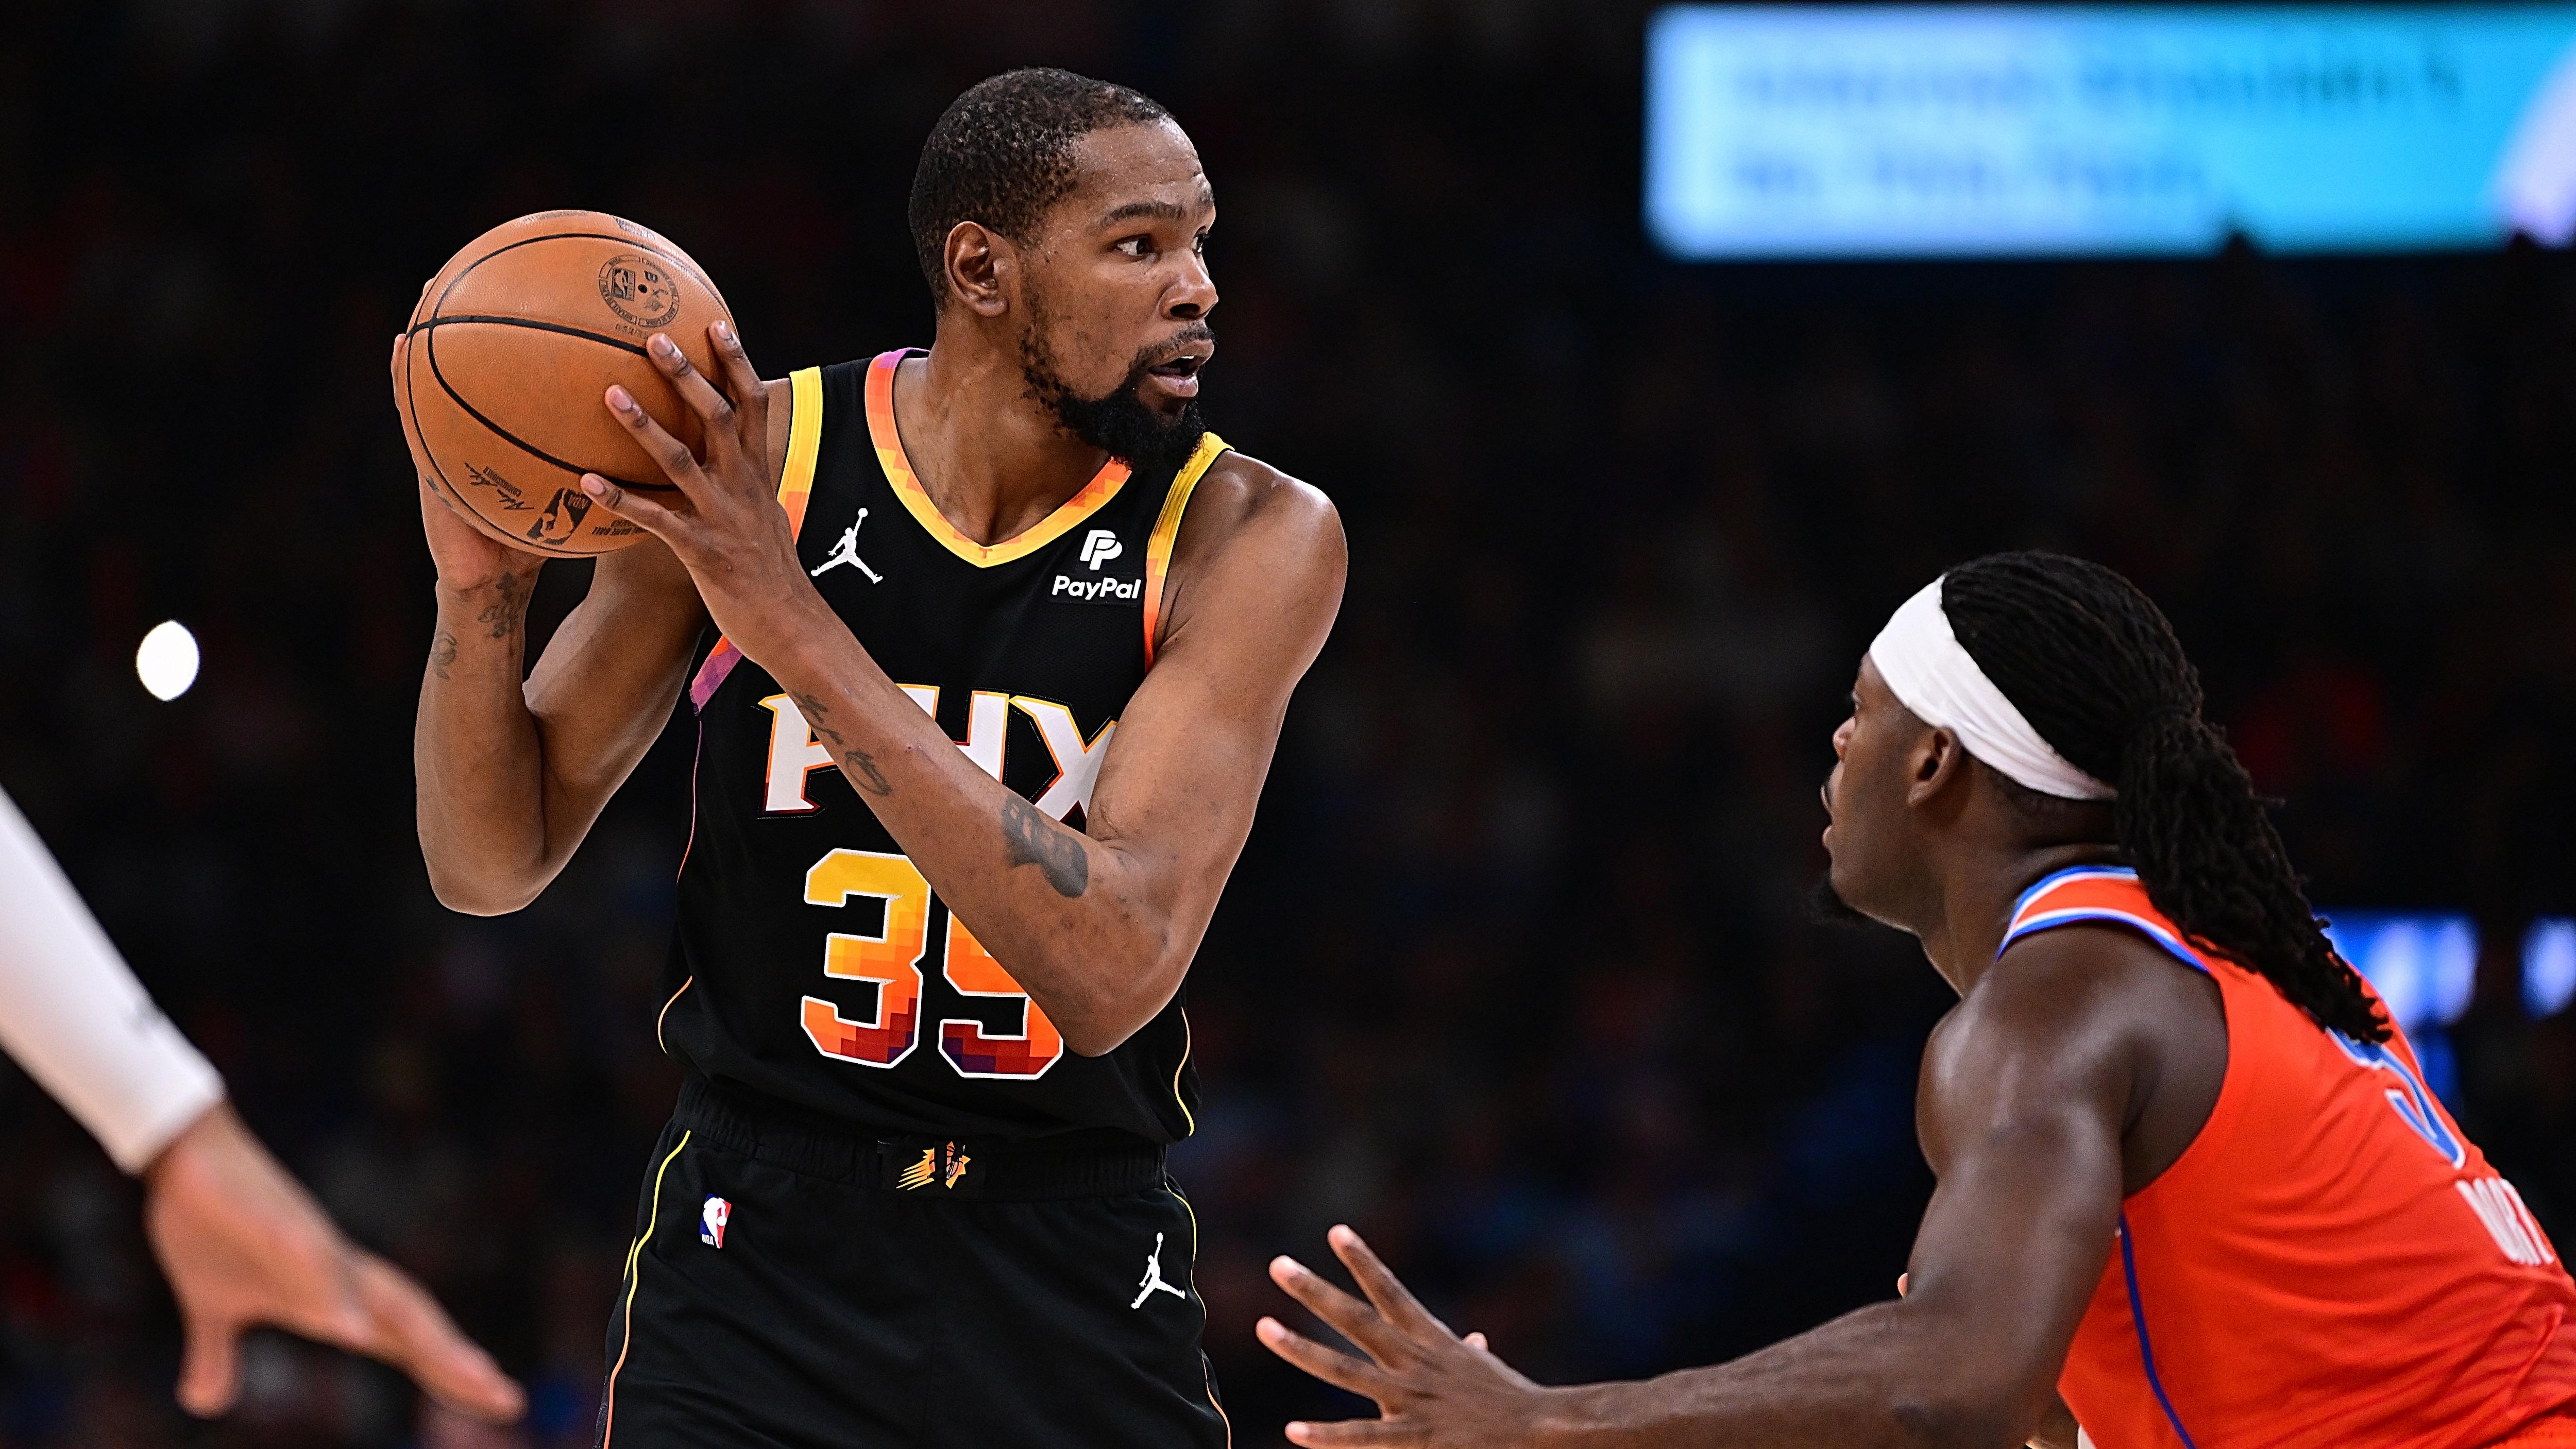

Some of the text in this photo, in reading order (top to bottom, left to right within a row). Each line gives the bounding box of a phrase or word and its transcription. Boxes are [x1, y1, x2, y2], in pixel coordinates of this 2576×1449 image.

[1052, 575, 1142, 600] PayPal
[800, 847, 1063, 1080] 35
[701, 1233, 715, 1246] NBA
